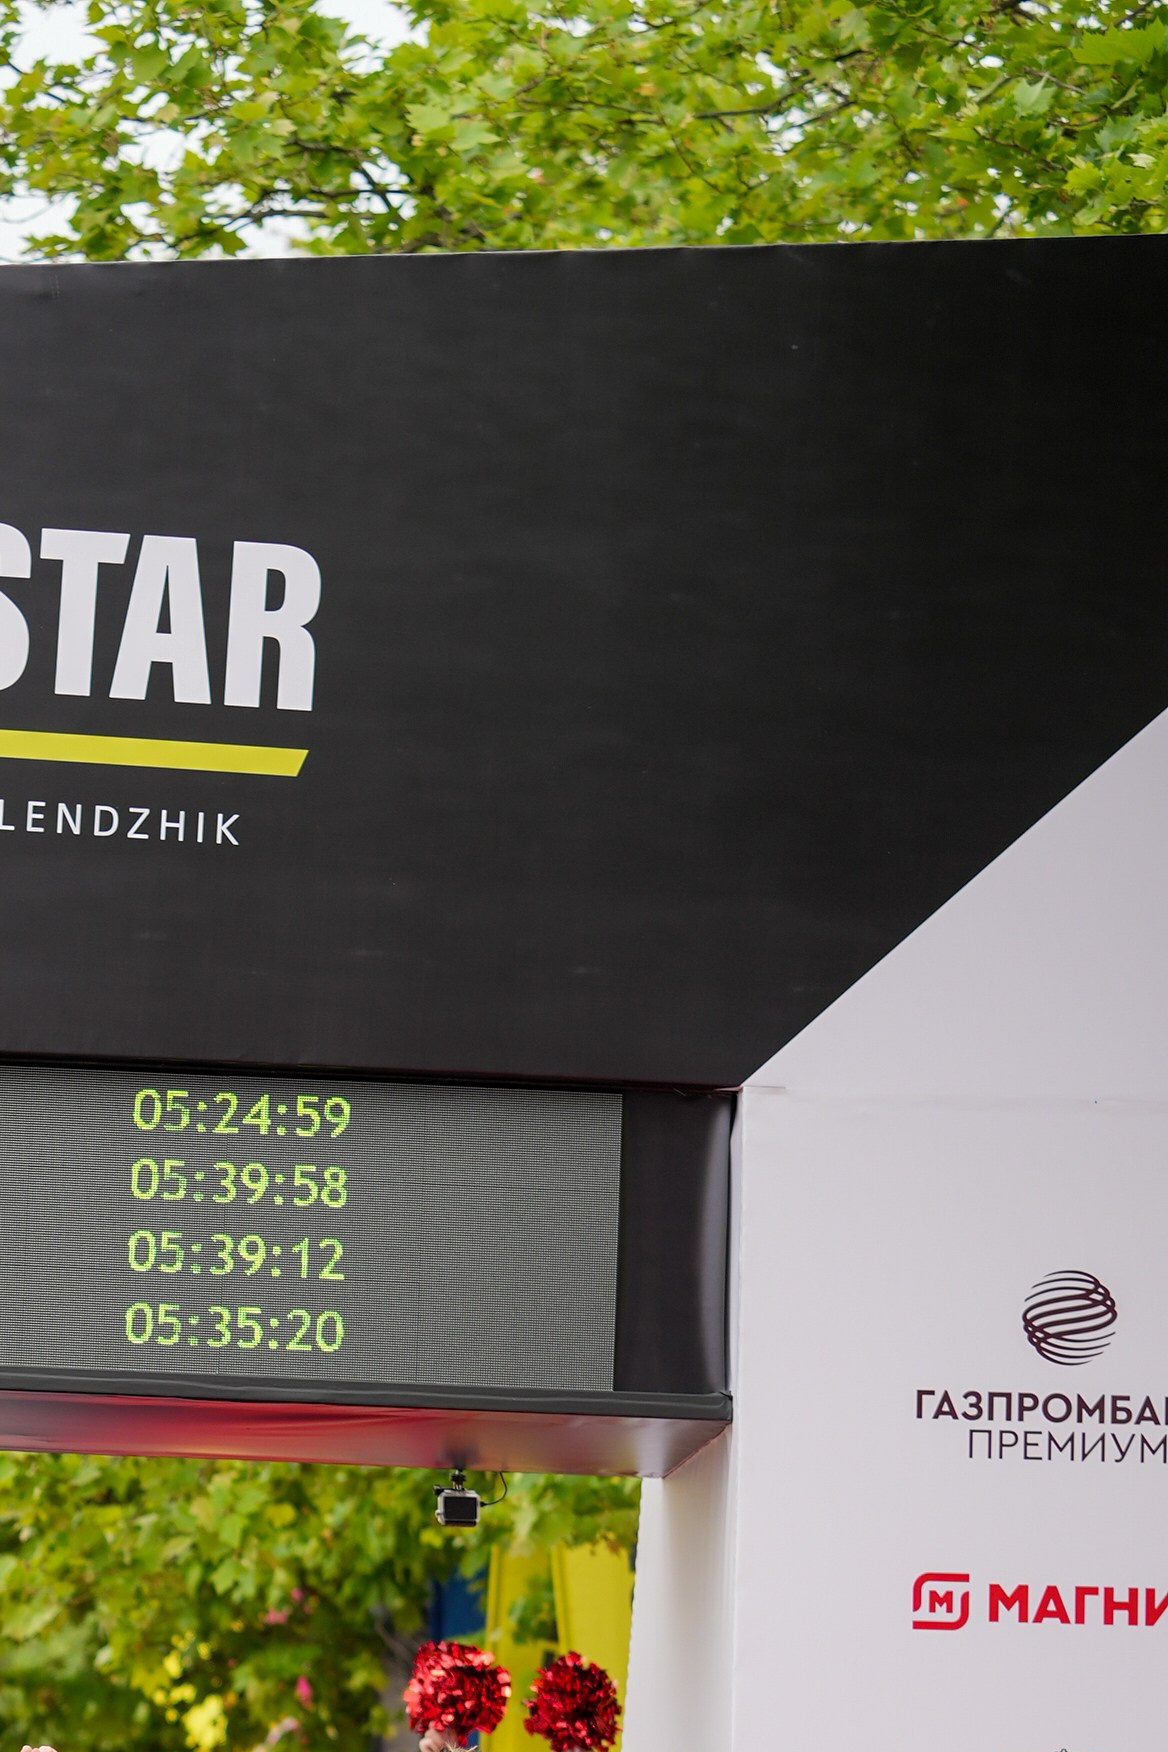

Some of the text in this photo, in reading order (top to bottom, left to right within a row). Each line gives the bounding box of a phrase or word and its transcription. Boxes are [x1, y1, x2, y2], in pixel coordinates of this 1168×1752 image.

[132, 1088, 352, 1137] 05:24:59
[131, 1157, 348, 1207] 05:39:58
[128, 1229, 346, 1280] 05:39:12
[125, 1301, 346, 1352] 05:35:20
[916, 1389, 1168, 1426] ГАЗПРОМБА
[968, 1429, 1168, 1464] ПРЕМИУМ
